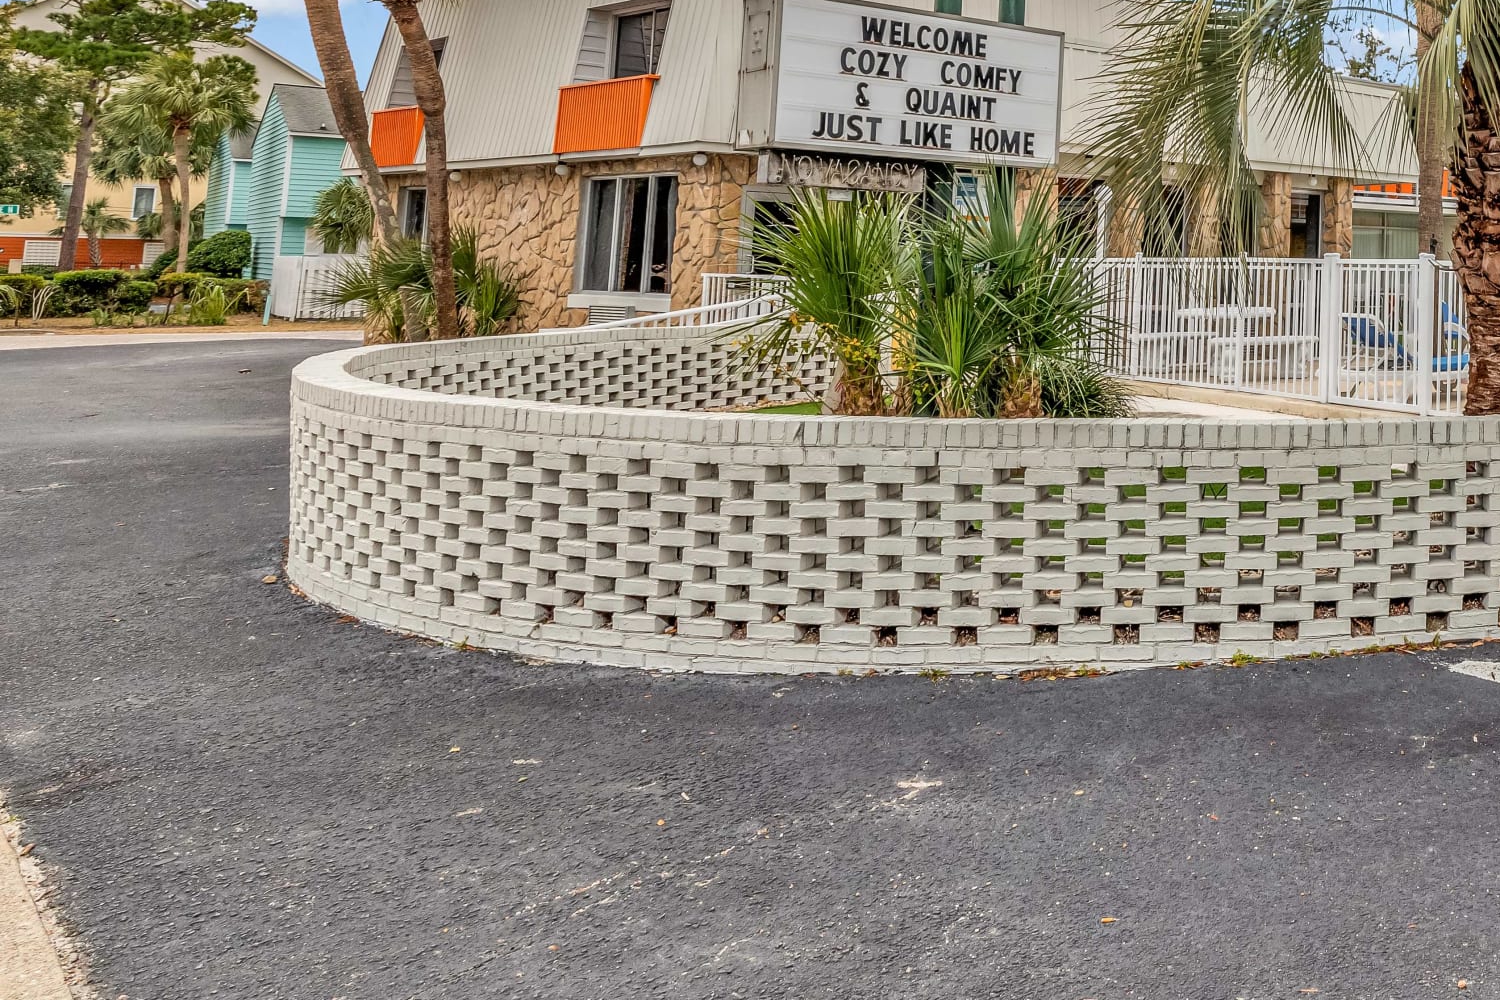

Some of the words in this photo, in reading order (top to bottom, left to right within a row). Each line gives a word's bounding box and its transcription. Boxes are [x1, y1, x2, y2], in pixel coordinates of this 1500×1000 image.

[861, 16, 988, 58] WELCOME
[840, 47, 908, 79] COZY
[941, 60, 1022, 93] COMFY
[855, 82, 870, 107] &
[905, 88, 997, 121] QUAINT
[812, 112, 883, 142] JUST
[900, 120, 952, 148] LIKE
[970, 126, 1035, 156] HOME
[779, 153, 813, 183] NO
